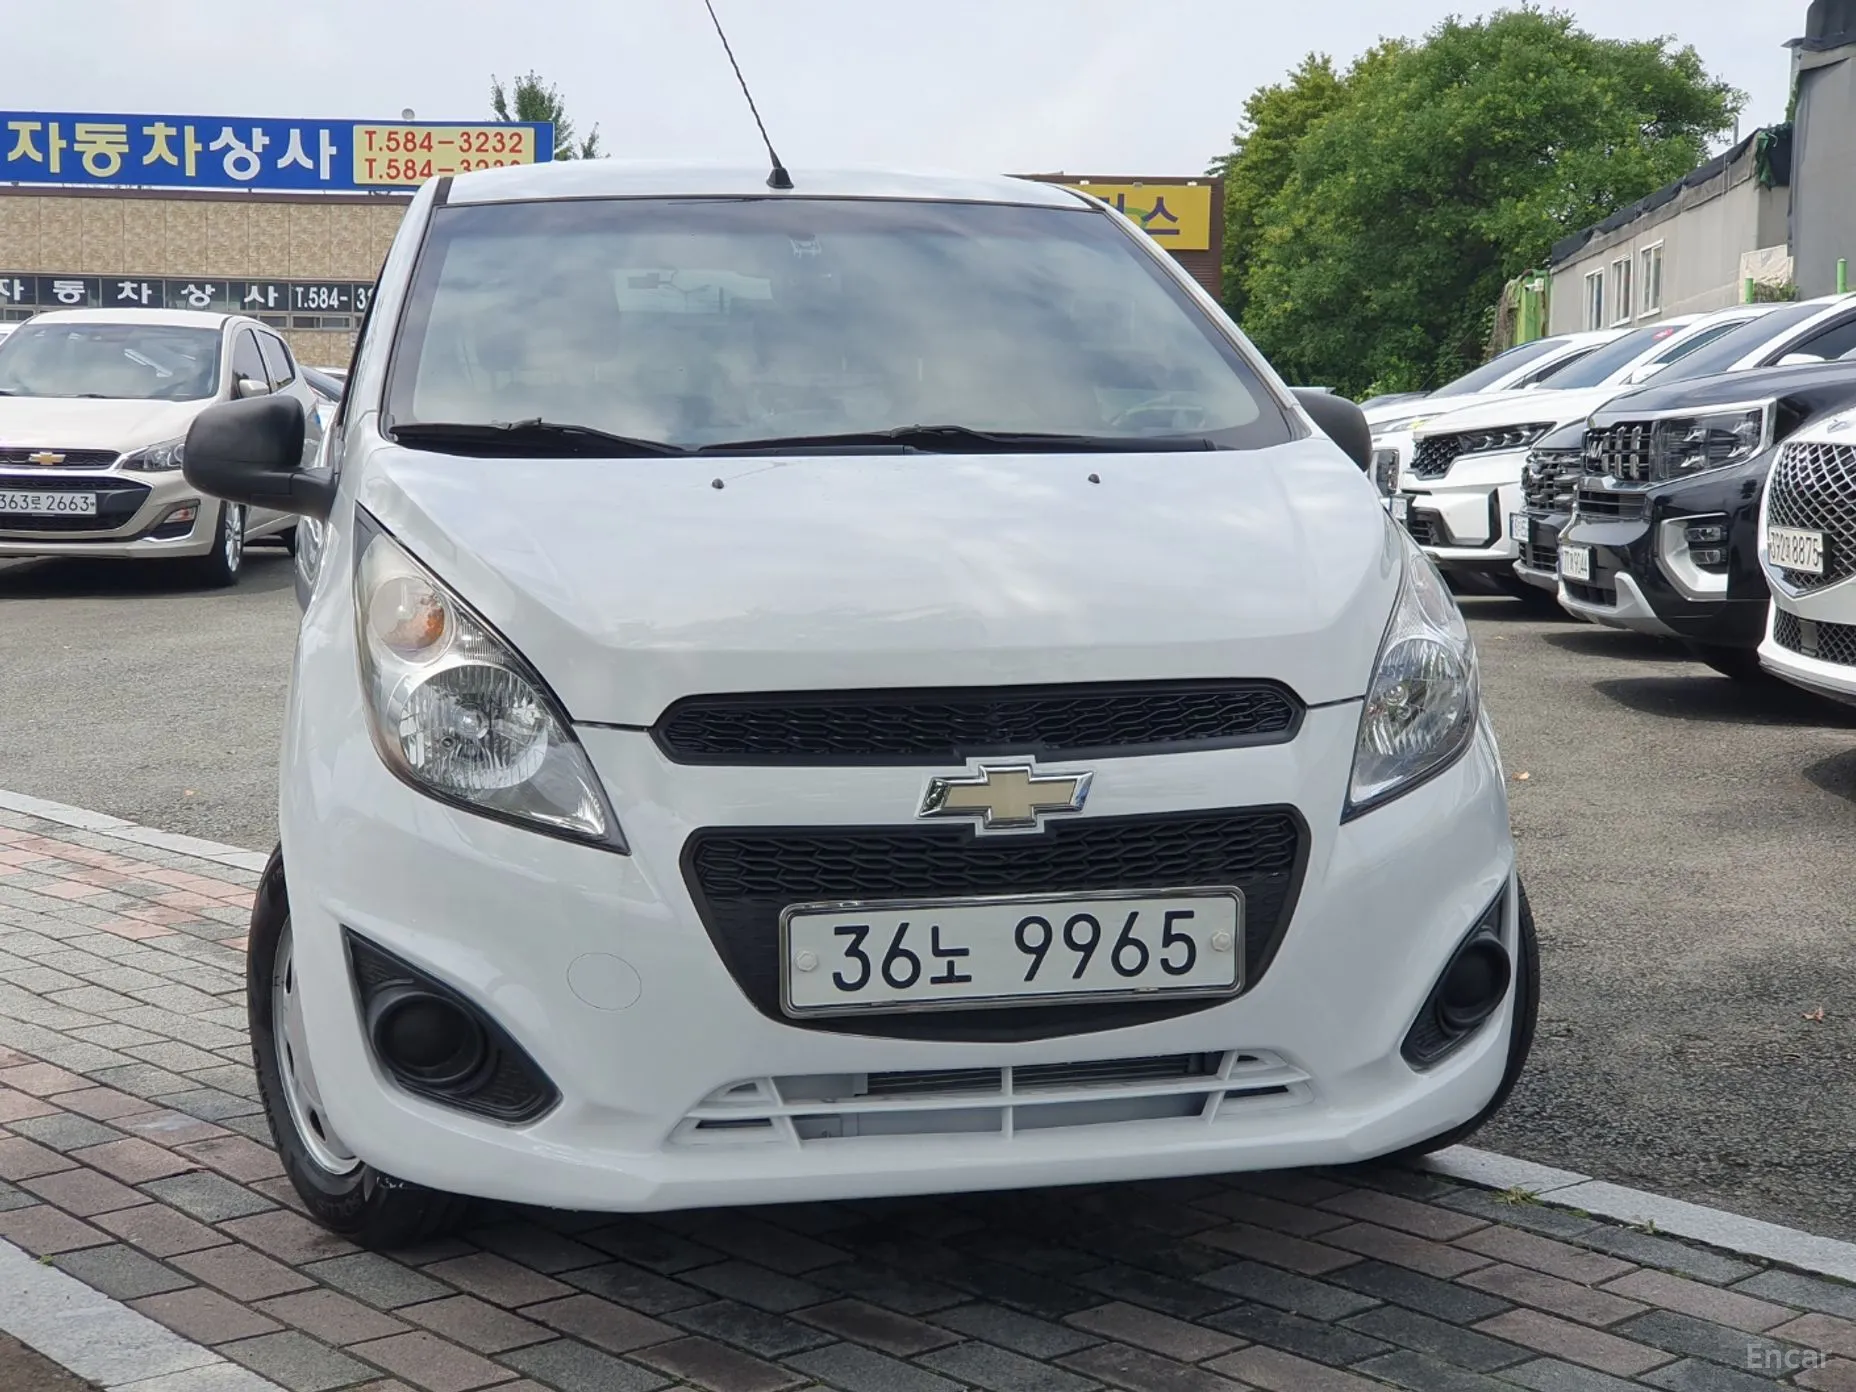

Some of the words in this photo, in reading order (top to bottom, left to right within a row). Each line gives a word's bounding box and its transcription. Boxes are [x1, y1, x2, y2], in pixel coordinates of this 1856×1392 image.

[364, 130, 523, 153] T.584-3232
[364, 158, 521, 180] T.584-3
[46, 495, 89, 512] 2663
[832, 921, 973, 993] 36노
[1013, 910, 1197, 983] 9965
